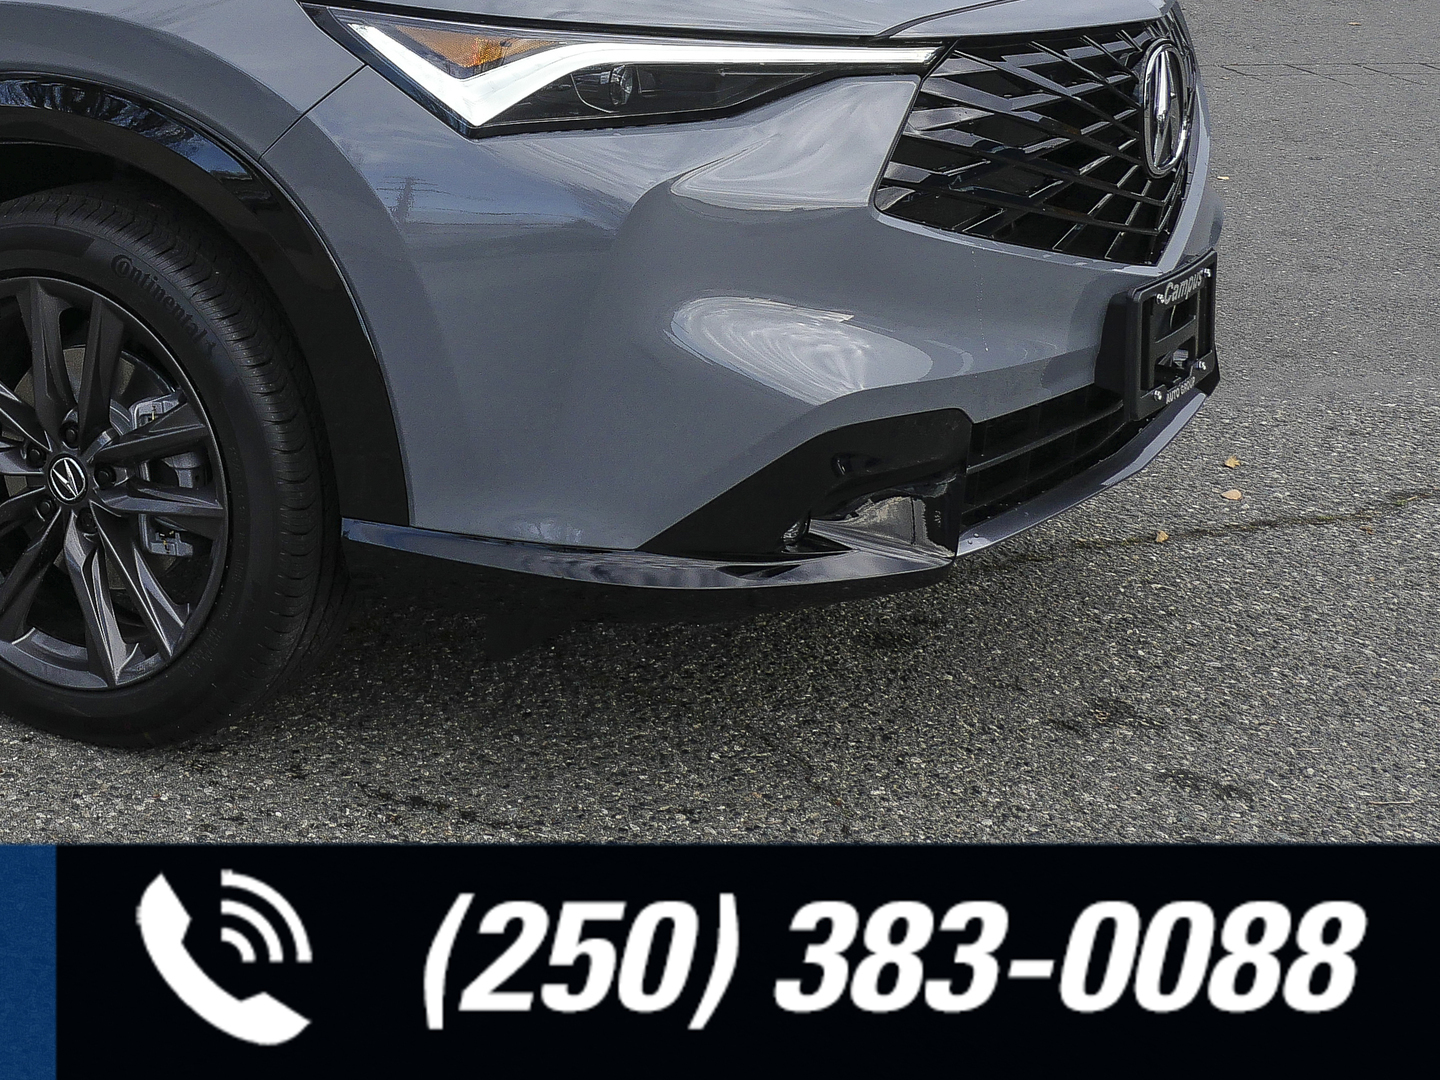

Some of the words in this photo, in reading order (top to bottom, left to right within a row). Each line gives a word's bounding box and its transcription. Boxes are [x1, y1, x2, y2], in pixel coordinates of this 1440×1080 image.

[111, 254, 208, 343] Continental
[1164, 270, 1203, 306] Campus
[1165, 386, 1181, 405] AUTO
[1180, 376, 1197, 396] GROUP
